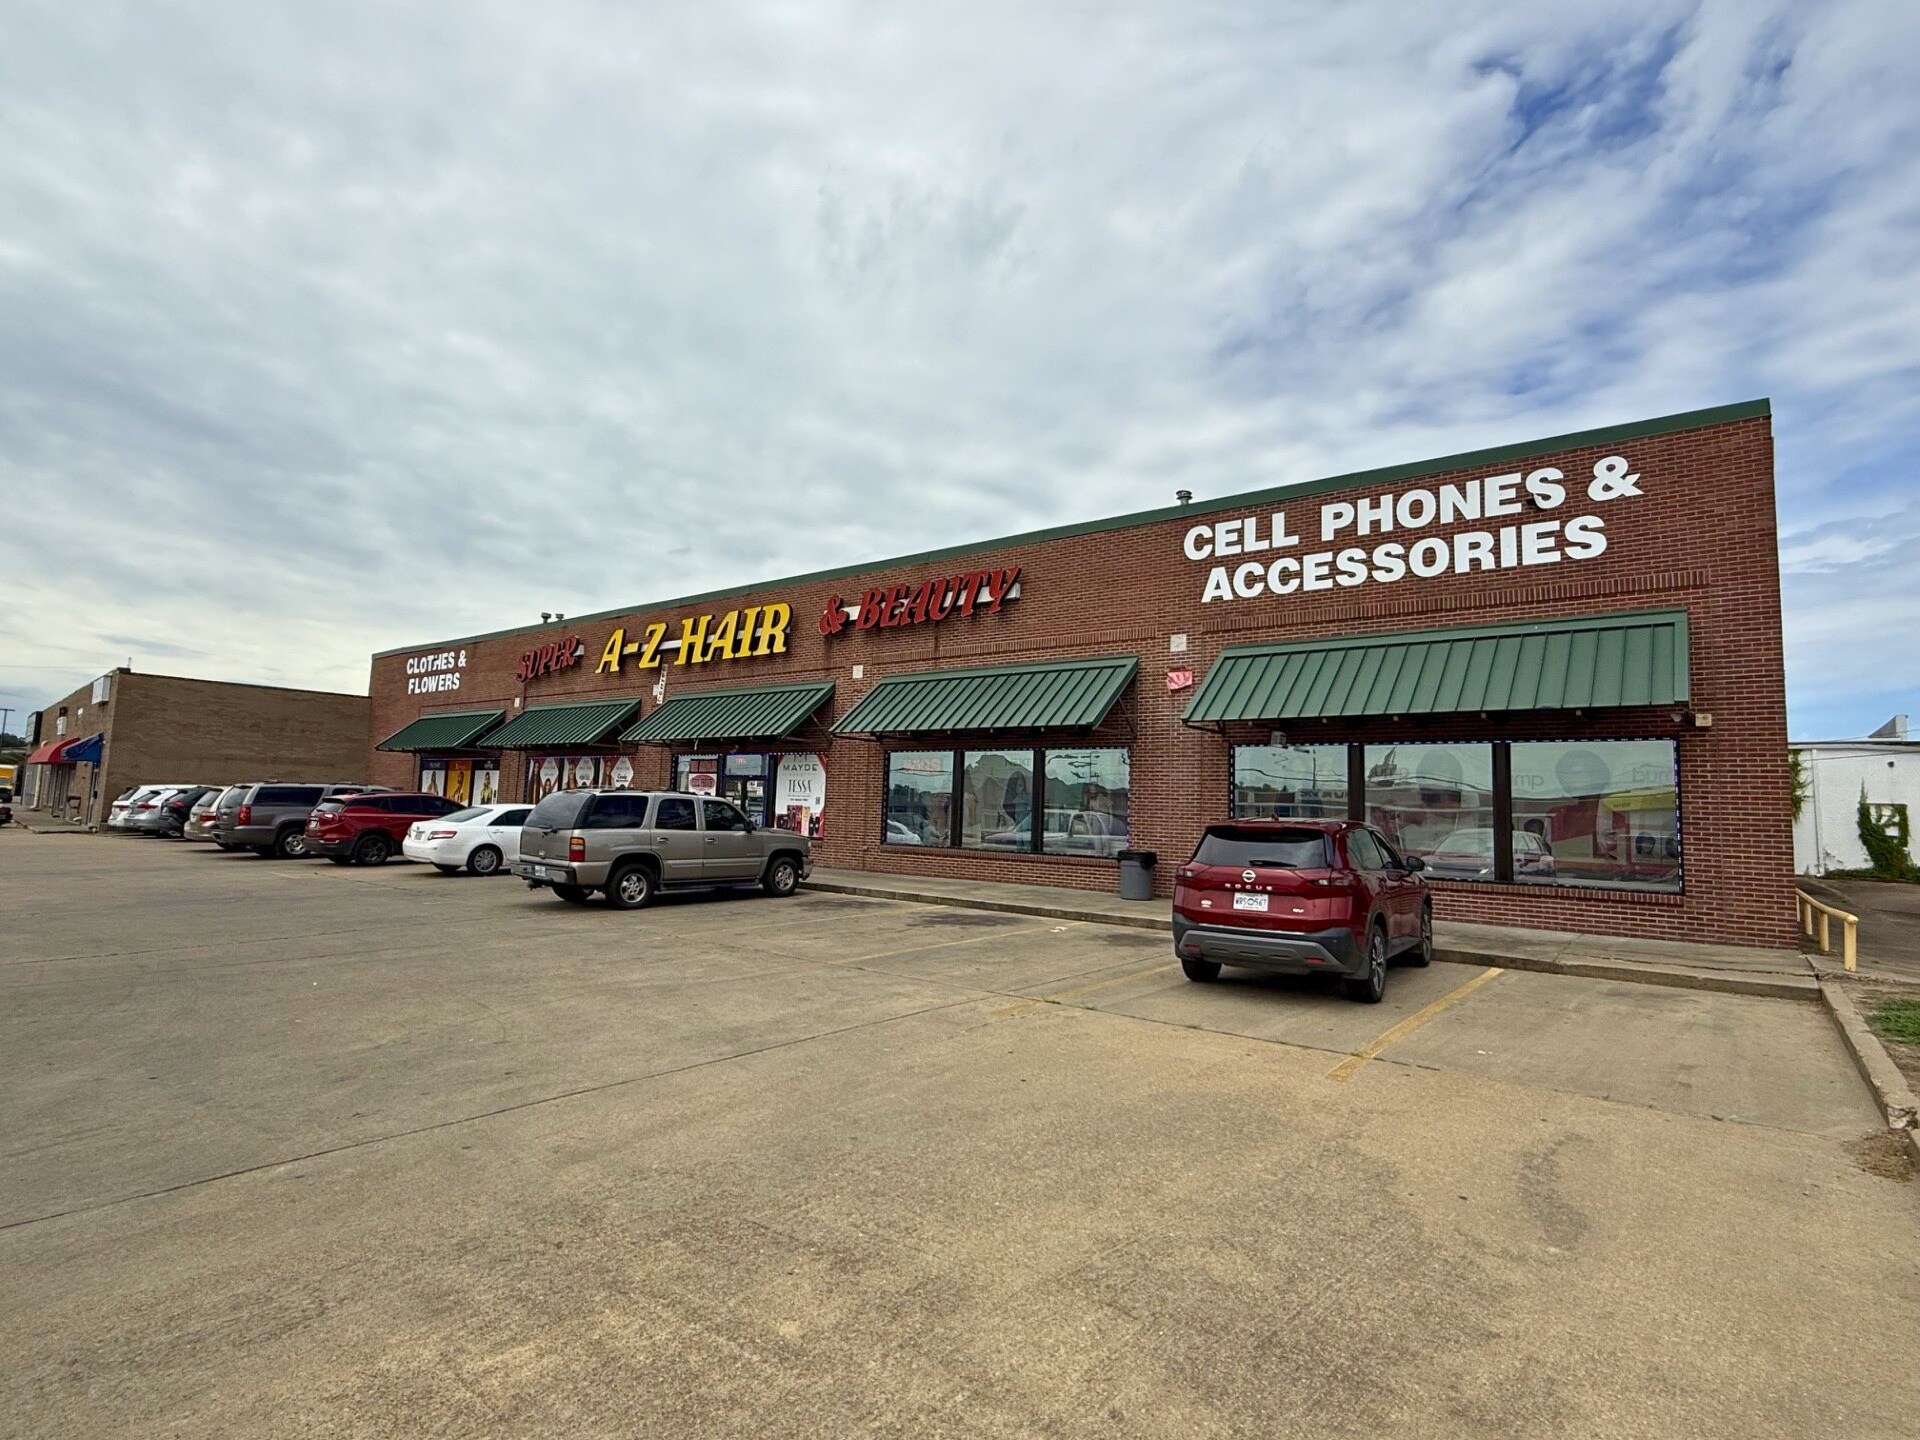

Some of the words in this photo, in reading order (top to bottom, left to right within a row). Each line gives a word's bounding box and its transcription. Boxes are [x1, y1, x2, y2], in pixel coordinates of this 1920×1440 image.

[1183, 511, 1300, 561] CELL
[1320, 467, 1567, 542] PHONES
[1587, 455, 1645, 502] &
[1201, 515, 1608, 604] ACCESSORIES
[516, 636, 579, 683] SUPER
[595, 622, 668, 674] A-Z
[673, 602, 793, 666] HAIR
[818, 593, 848, 636] &
[855, 565, 1021, 631] BEAUTY
[406, 651, 456, 675] CLOTHES
[457, 649, 467, 668] &
[407, 672, 461, 695] FLOWERS
[783, 763, 819, 772] MAYDE
